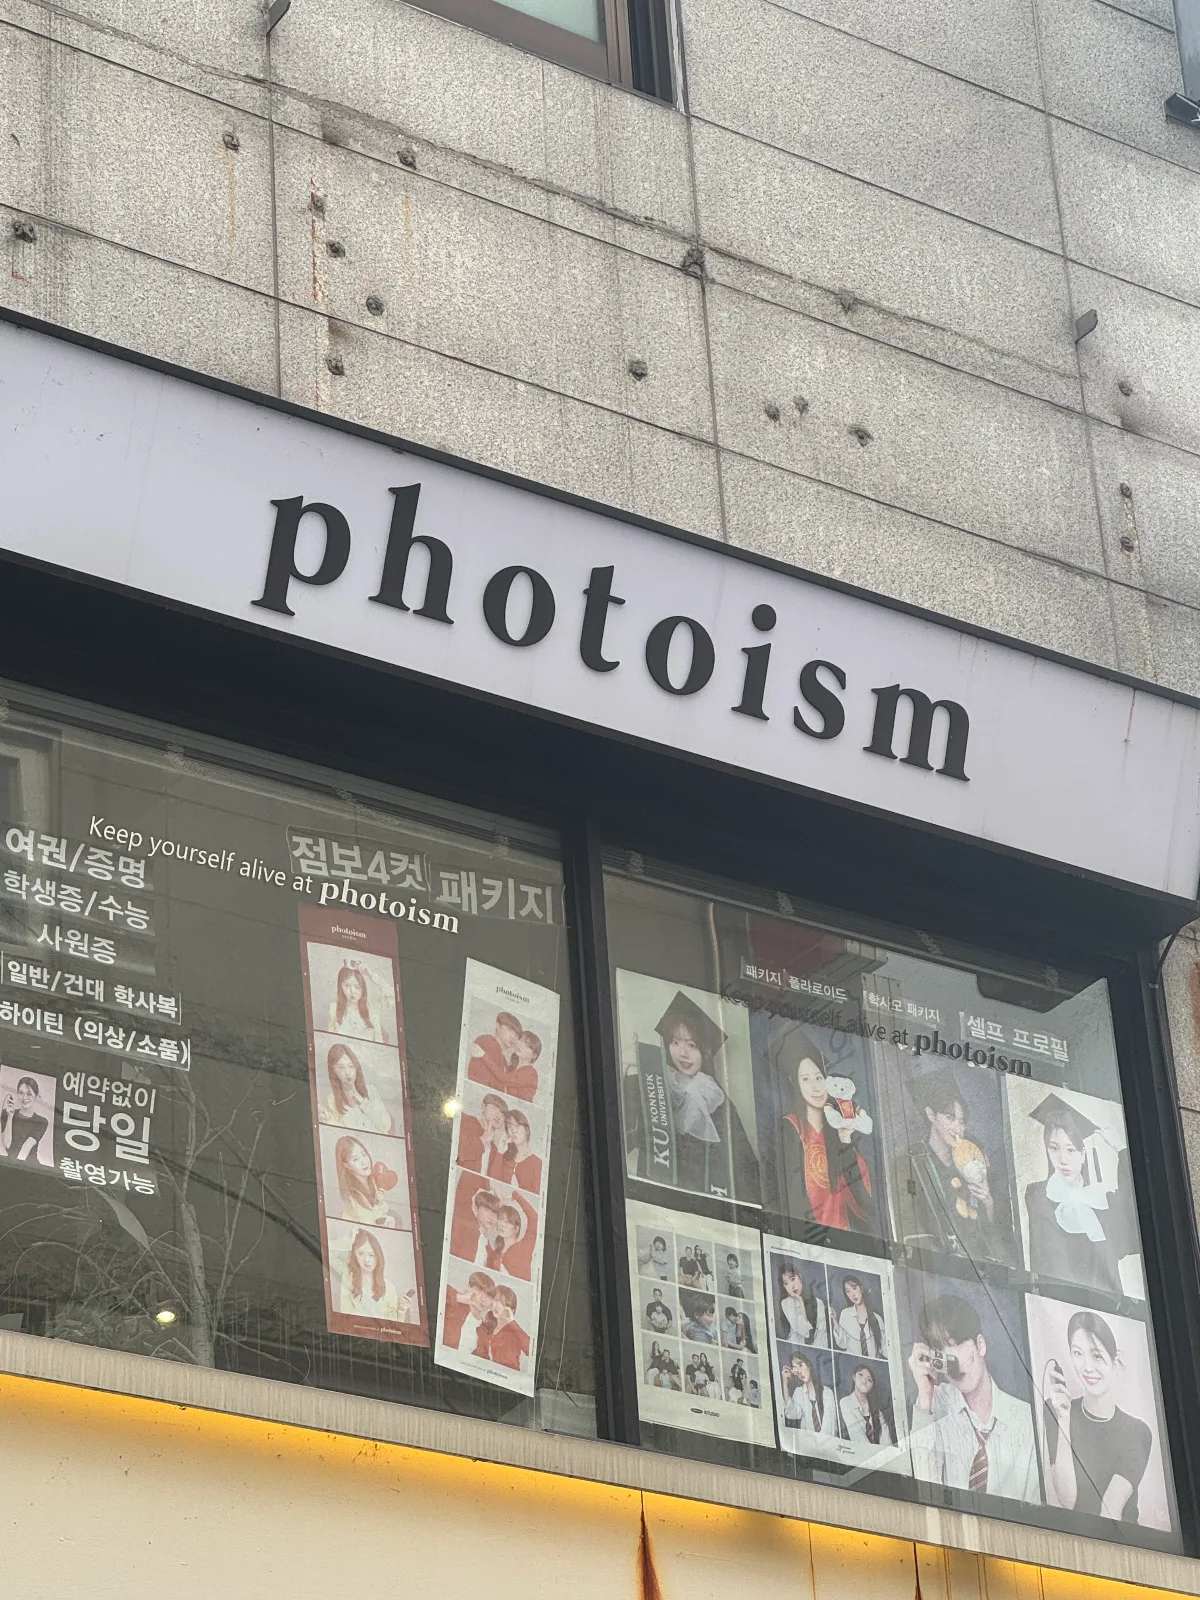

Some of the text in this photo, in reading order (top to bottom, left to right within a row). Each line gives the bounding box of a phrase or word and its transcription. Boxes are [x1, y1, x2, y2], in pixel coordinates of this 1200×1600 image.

[250, 482, 971, 782] photoism
[5, 827, 146, 889] 여권/증명
[89, 815, 460, 934] Keep yourself alive at photoism
[291, 835, 555, 924] 점보4컷 패키지
[4, 869, 150, 930] 학생증/수능
[37, 923, 117, 965] 사원증
[331, 924, 367, 939] photoism
[7, 960, 178, 1019] 일반/건대 학사복
[745, 964, 782, 986] 패키지
[906, 1002, 941, 1023] 패키지
[74, 1016, 188, 1065] (의상/소품)
[892, 1028, 909, 1047] at
[913, 1030, 1033, 1078] photoism
[966, 1014, 1070, 1063] 셀프 프로필
[62, 1071, 156, 1114] 예약없이
[645, 1073, 659, 1123] KONKUK
[655, 1075, 668, 1126] UNIVERSITY
[62, 1101, 151, 1165] 당일
[652, 1126, 670, 1168] KU
[59, 1156, 156, 1195] 촬영가능
